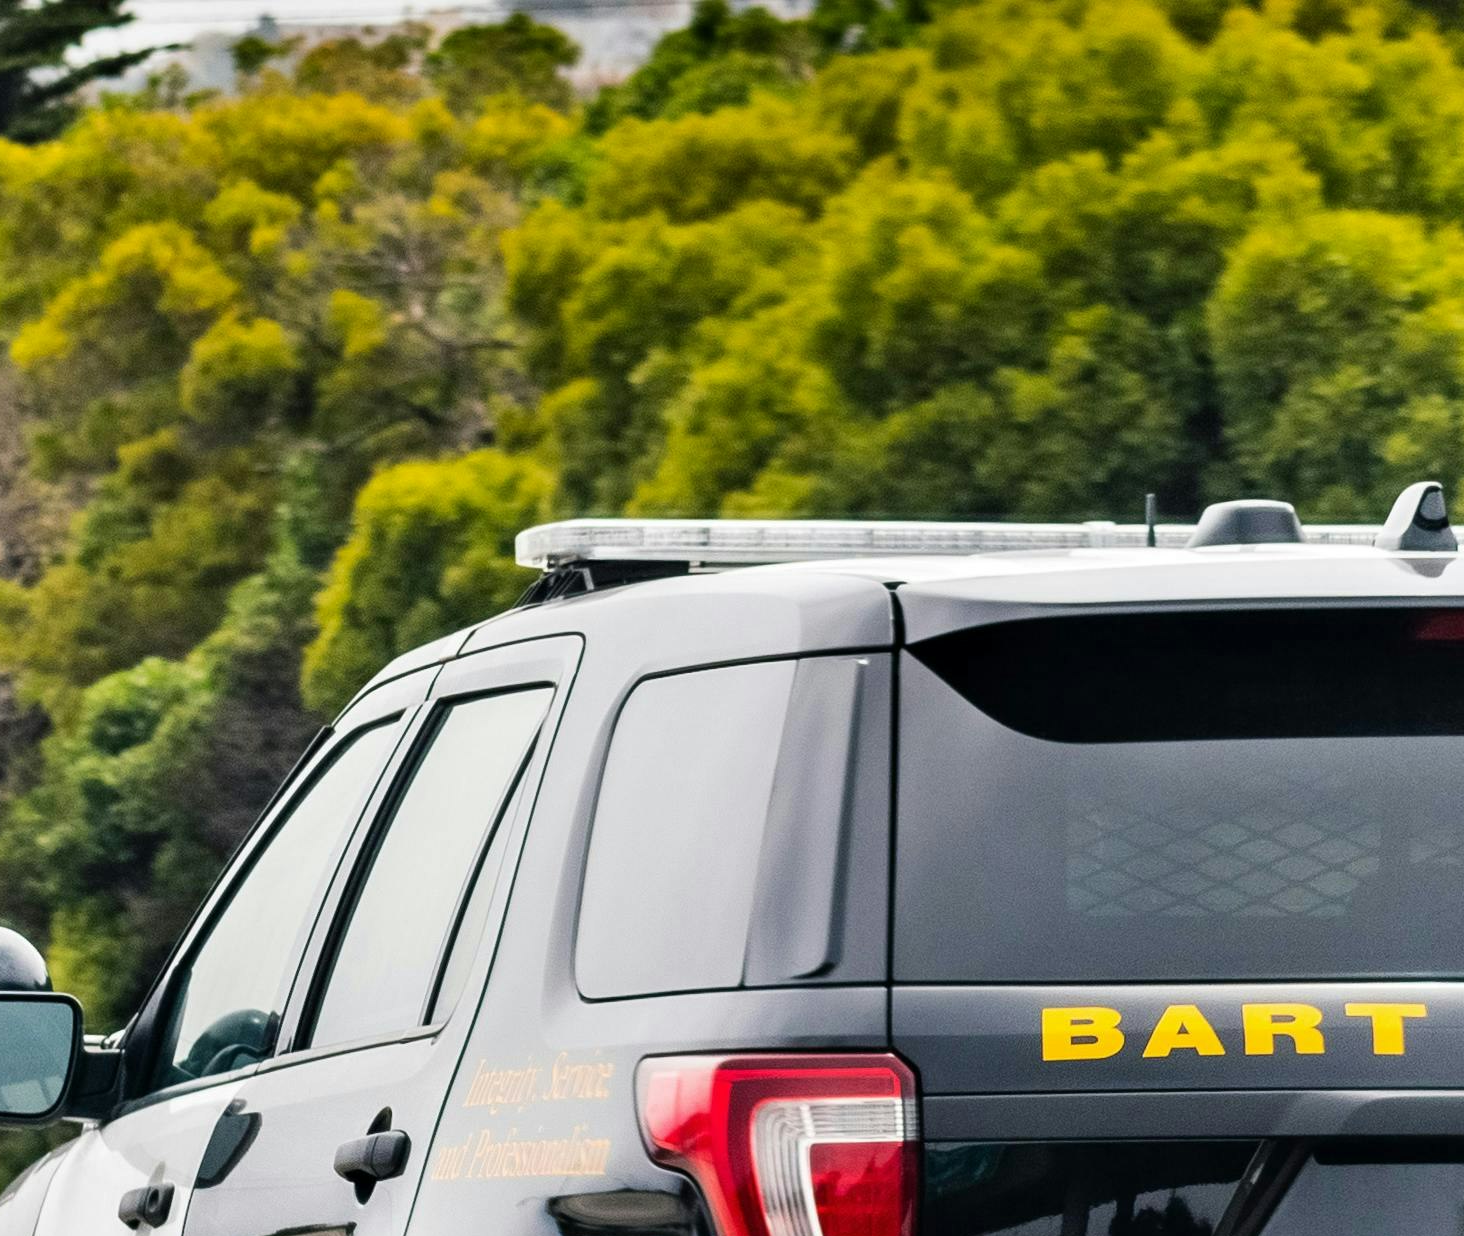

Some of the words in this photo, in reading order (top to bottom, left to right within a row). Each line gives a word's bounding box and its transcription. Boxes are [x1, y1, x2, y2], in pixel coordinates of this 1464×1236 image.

[1041, 1002, 1428, 1062] BART
[542, 1050, 616, 1100] Service
[430, 1131, 474, 1180] and
[466, 1122, 612, 1178] Professionalism
